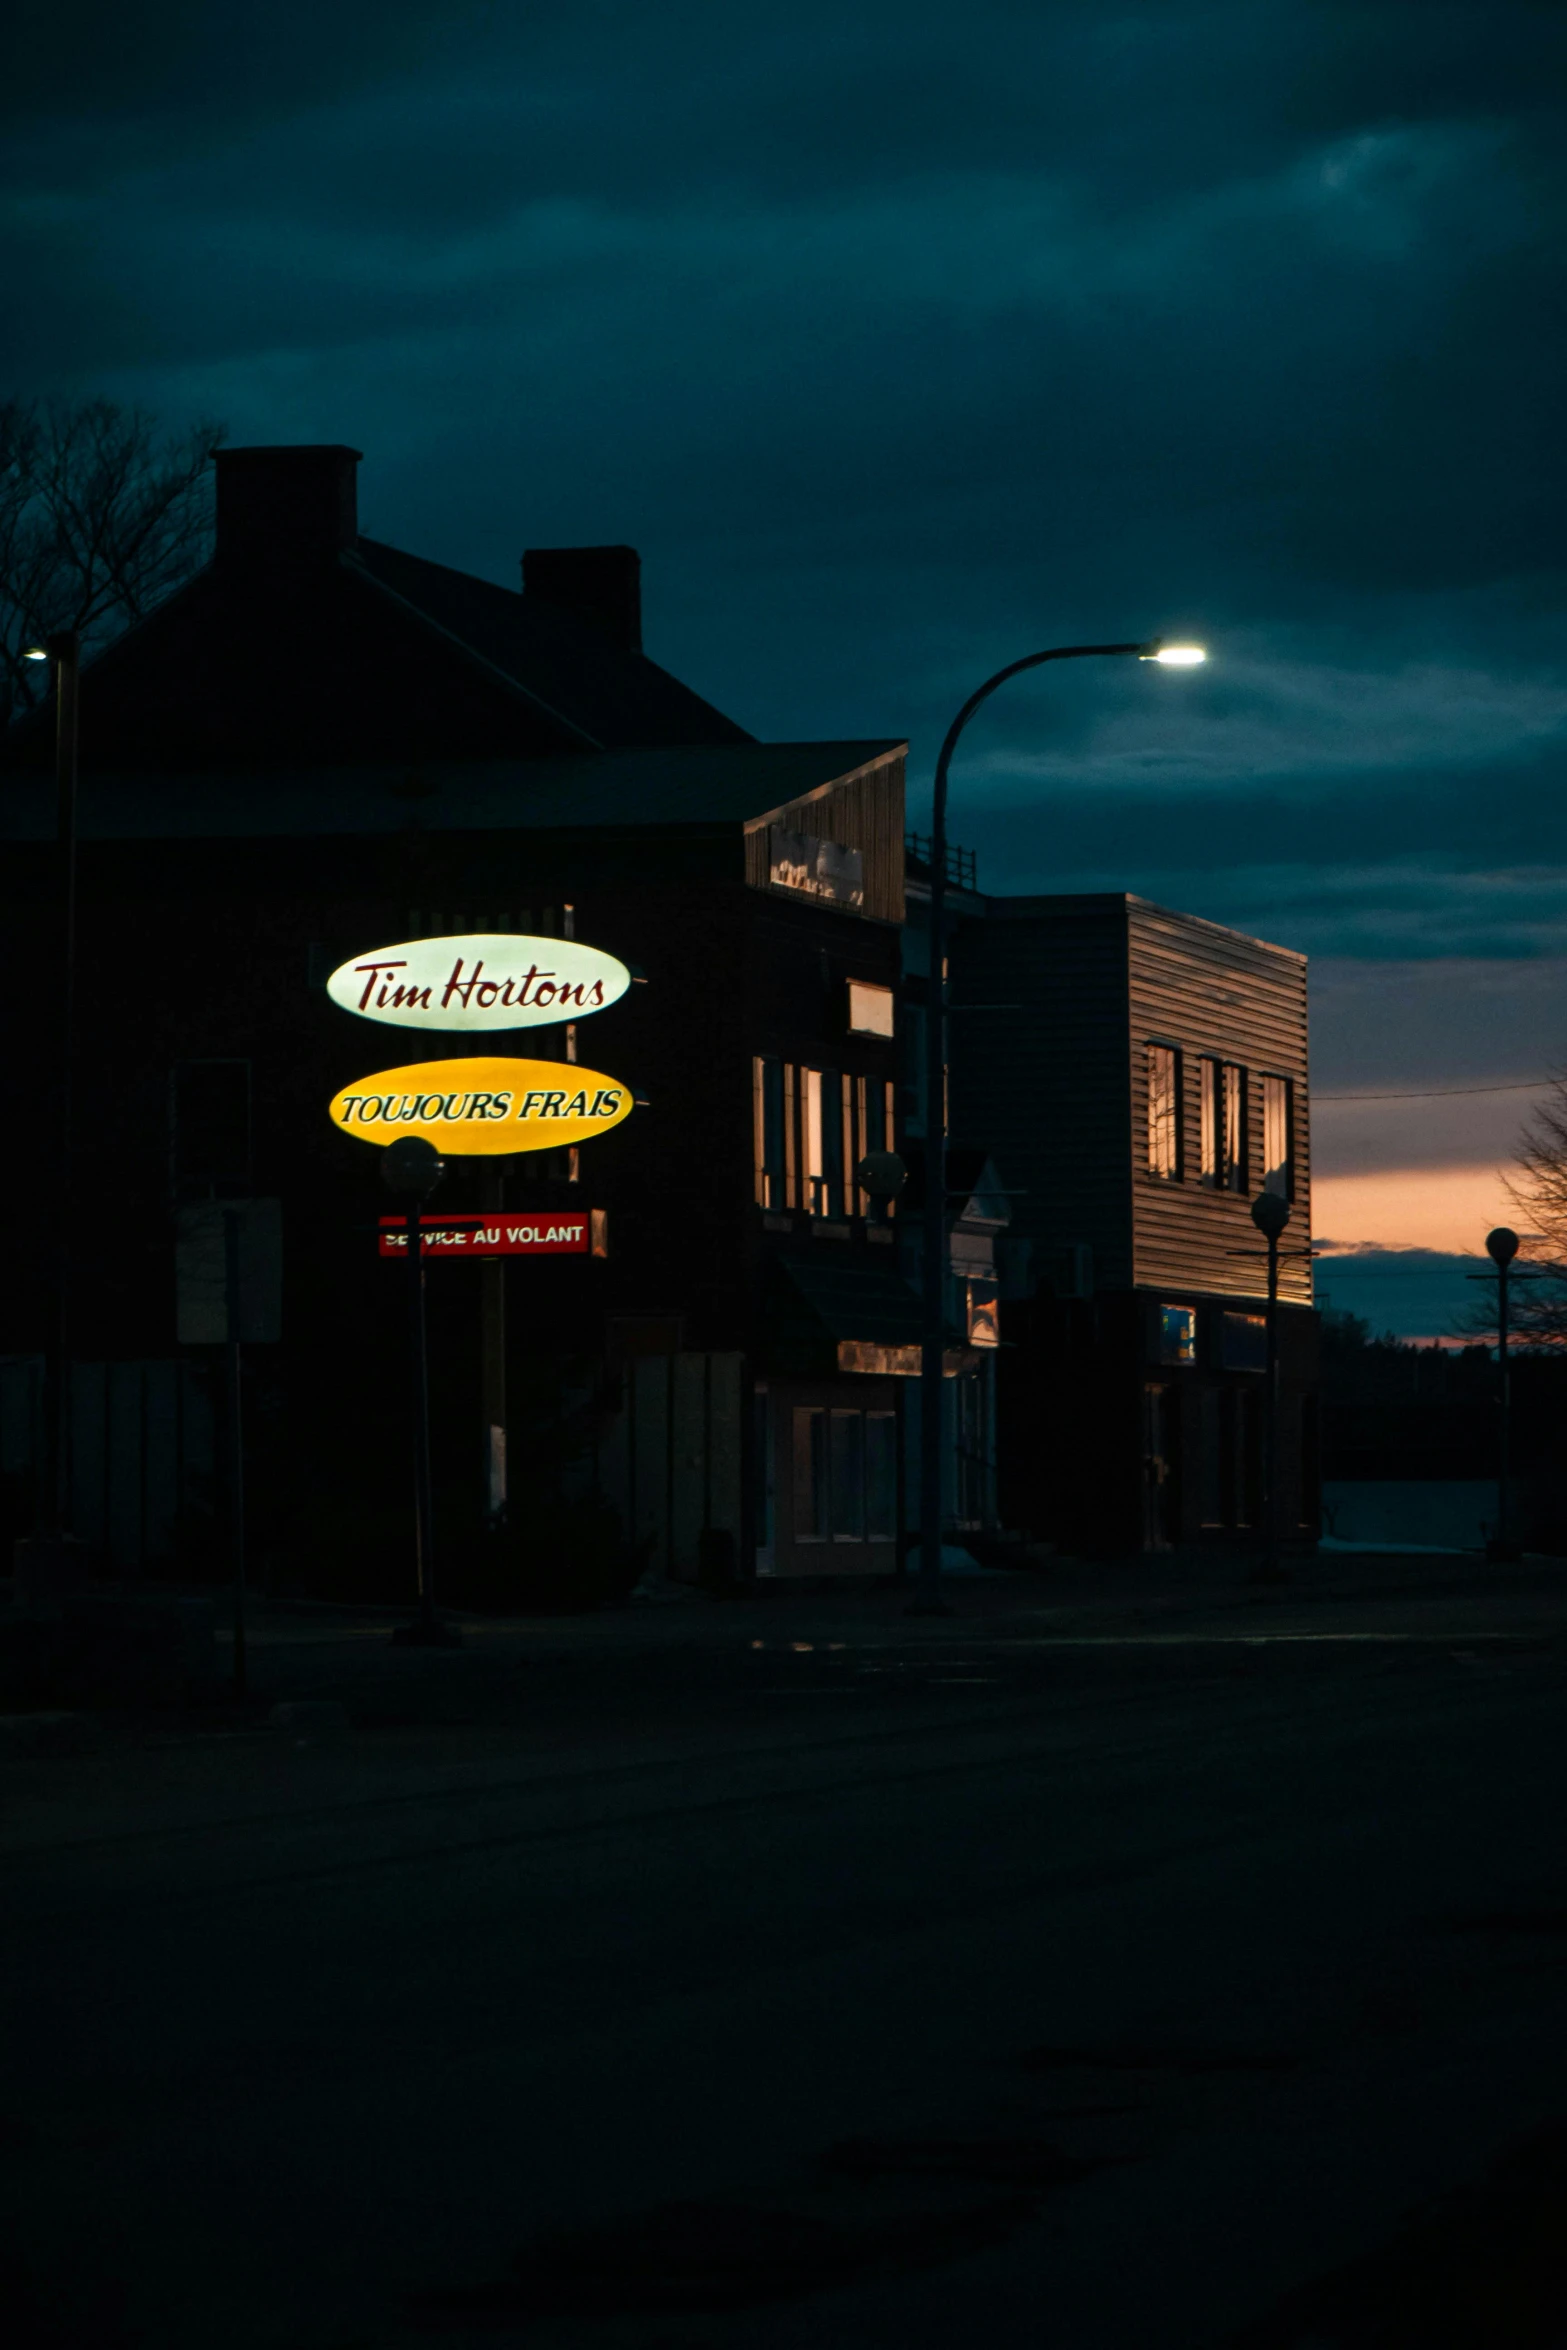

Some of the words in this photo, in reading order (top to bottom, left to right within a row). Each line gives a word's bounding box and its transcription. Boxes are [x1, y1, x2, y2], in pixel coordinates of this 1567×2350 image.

[354, 960, 434, 1012] Tim
[440, 957, 606, 1010] Hortons
[340, 1093, 512, 1123] TOUJOURS
[517, 1089, 624, 1119] FRAIS
[385, 1229, 467, 1245] SEVICE
[473, 1228, 501, 1244] AU
[506, 1225, 584, 1243] VOLANT
